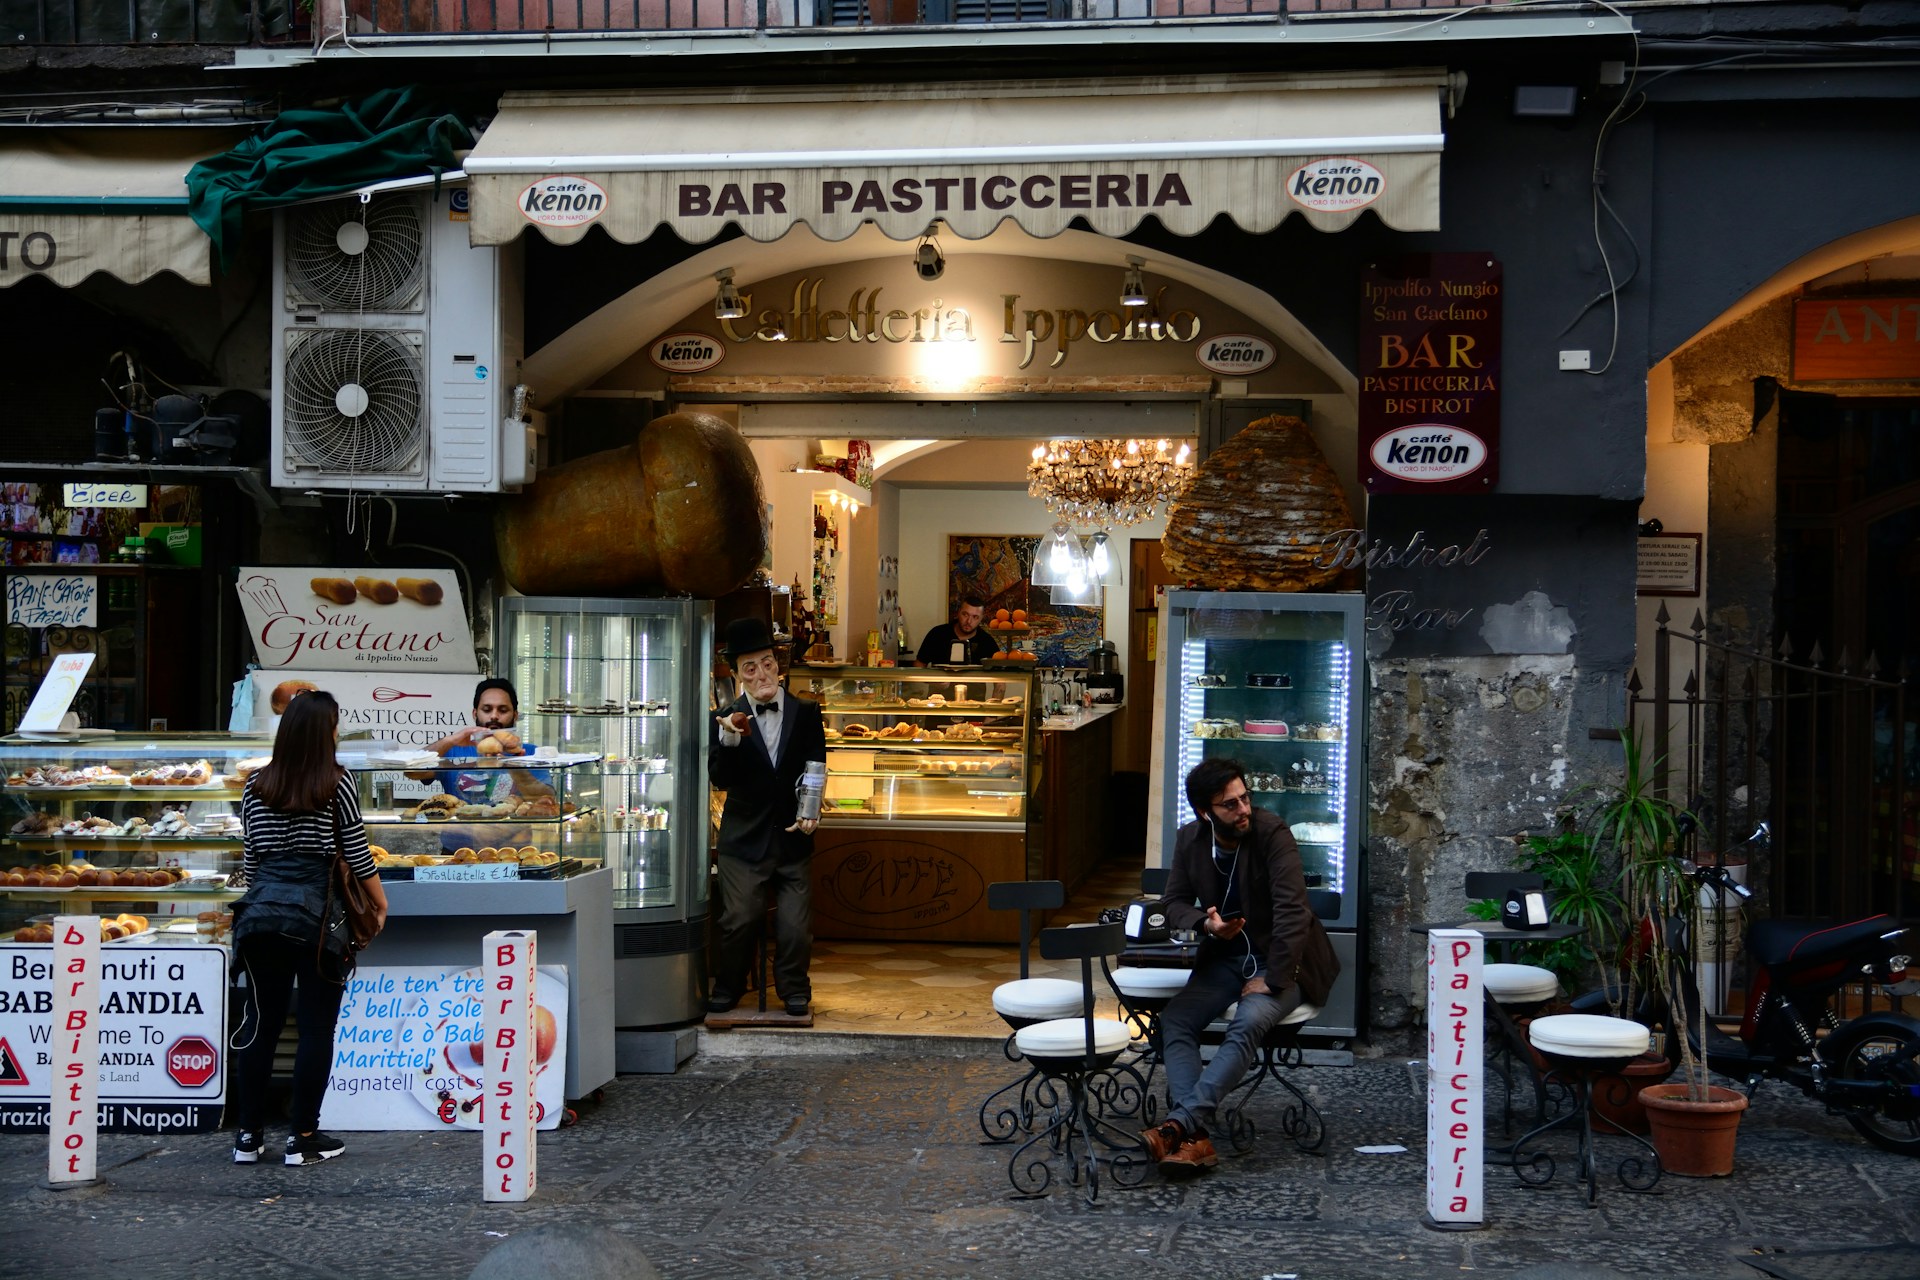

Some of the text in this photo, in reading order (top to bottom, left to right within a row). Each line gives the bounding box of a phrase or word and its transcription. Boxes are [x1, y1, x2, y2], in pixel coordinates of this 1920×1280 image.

[1294, 170, 1380, 195] kenon
[525, 187, 602, 211] kenon
[679, 173, 1192, 216] BAR PASTICCERIA
[1364, 277, 1499, 304] Ippolito Nunzio
[1374, 302, 1488, 321] San Gaetano
[660, 343, 713, 360] kenon
[1208, 343, 1264, 362] kenon
[1378, 332, 1483, 369] BAR
[1363, 375, 1496, 391] PASTICCERIA
[1385, 398, 1474, 414] BISTROT
[1387, 438, 1470, 463] kenon
[1314, 528, 1491, 570] Bistrot
[308, 604, 363, 626] San
[1366, 590, 1474, 631] Bar
[261, 616, 455, 667] Gaetano
[355, 652, 439, 664] di Ippolito Nunzio
[168, 964, 184, 980] a
[439, 998, 482, 1018] Sole
[139, 1026, 164, 1045] To
[338, 1026, 393, 1043] Mare
[402, 1028, 414, 1043] e
[172, 1055, 212, 1070] STOP
[110, 1072, 140, 1082] Land
[425, 1077, 464, 1091] cost
[1449, 941, 1471, 1213] Pasticceria
[123, 1106, 199, 1132] Napoli
[437, 1098, 457, 1123] €
[495, 1028, 516, 1193] Bistrot
